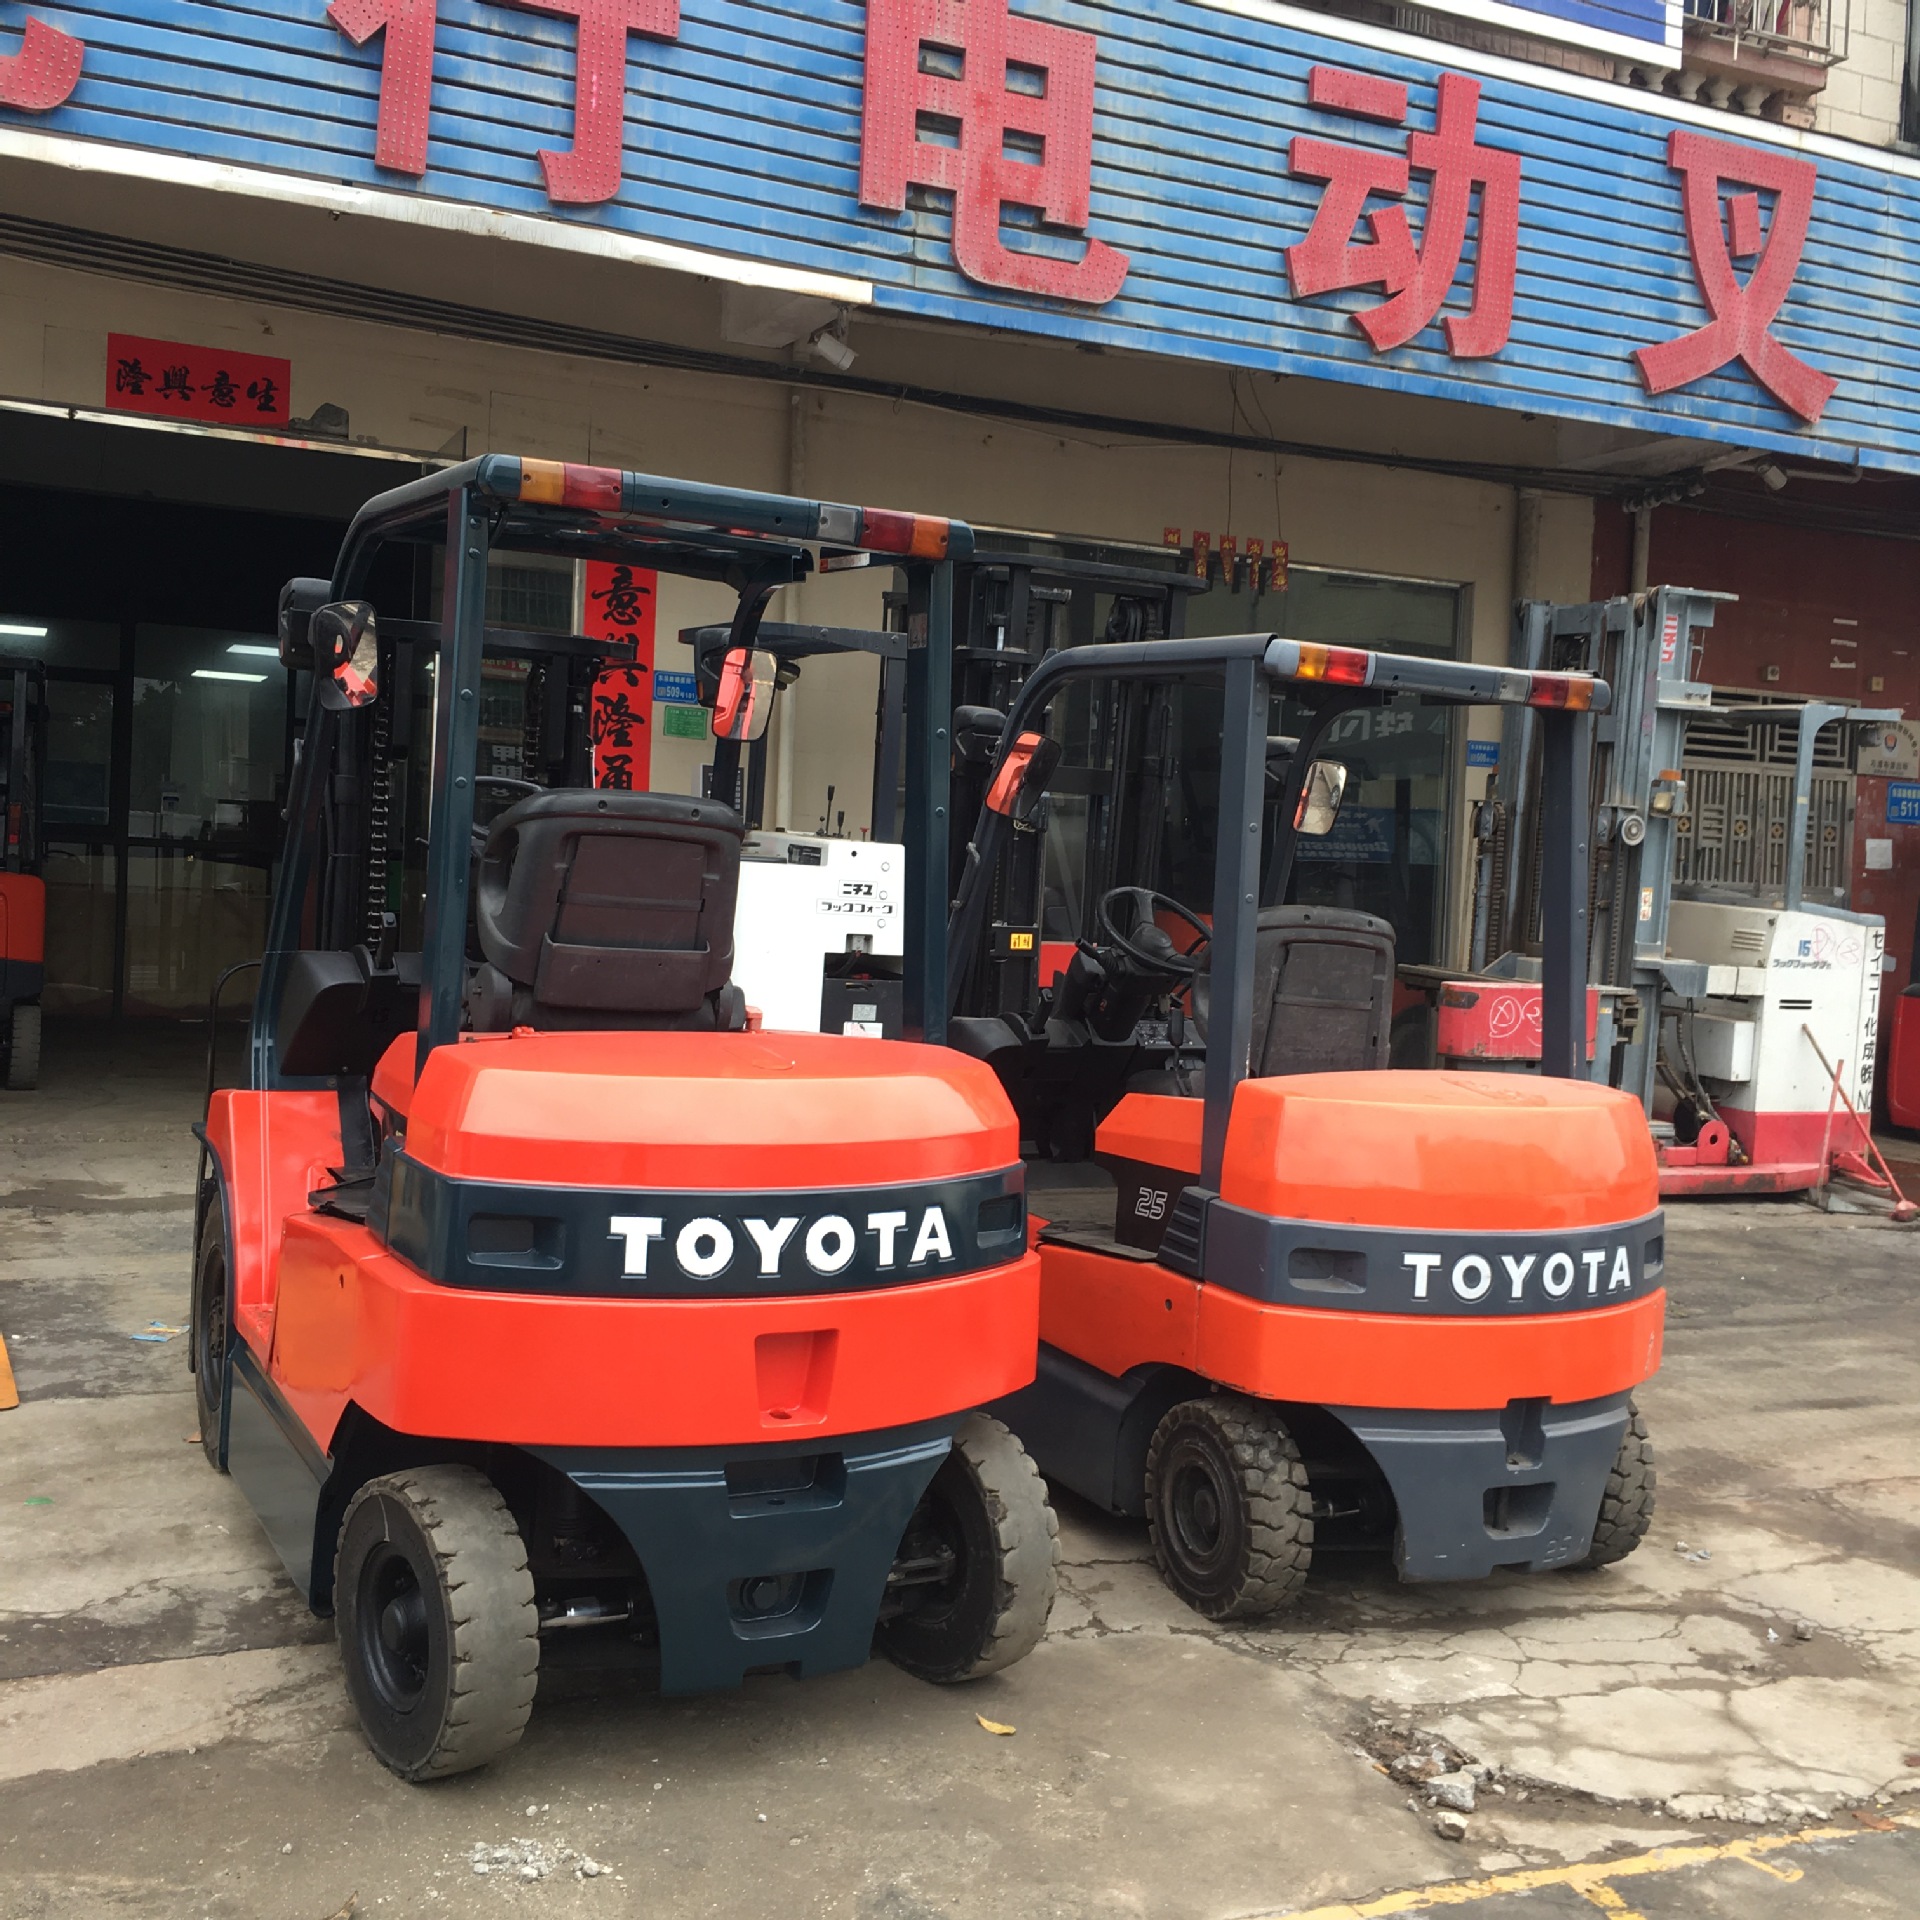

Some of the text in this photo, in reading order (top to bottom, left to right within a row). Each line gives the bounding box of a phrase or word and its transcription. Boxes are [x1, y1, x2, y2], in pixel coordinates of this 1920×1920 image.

[0, 0, 1837, 434] 行电动叉
[1900, 800, 1919, 817] 511
[1797, 939, 1812, 957] 15
[1134, 1186, 1169, 1220] 25
[606, 1205, 956, 1279] TOYOTA
[1401, 1246, 1632, 1303] TOYOTA
